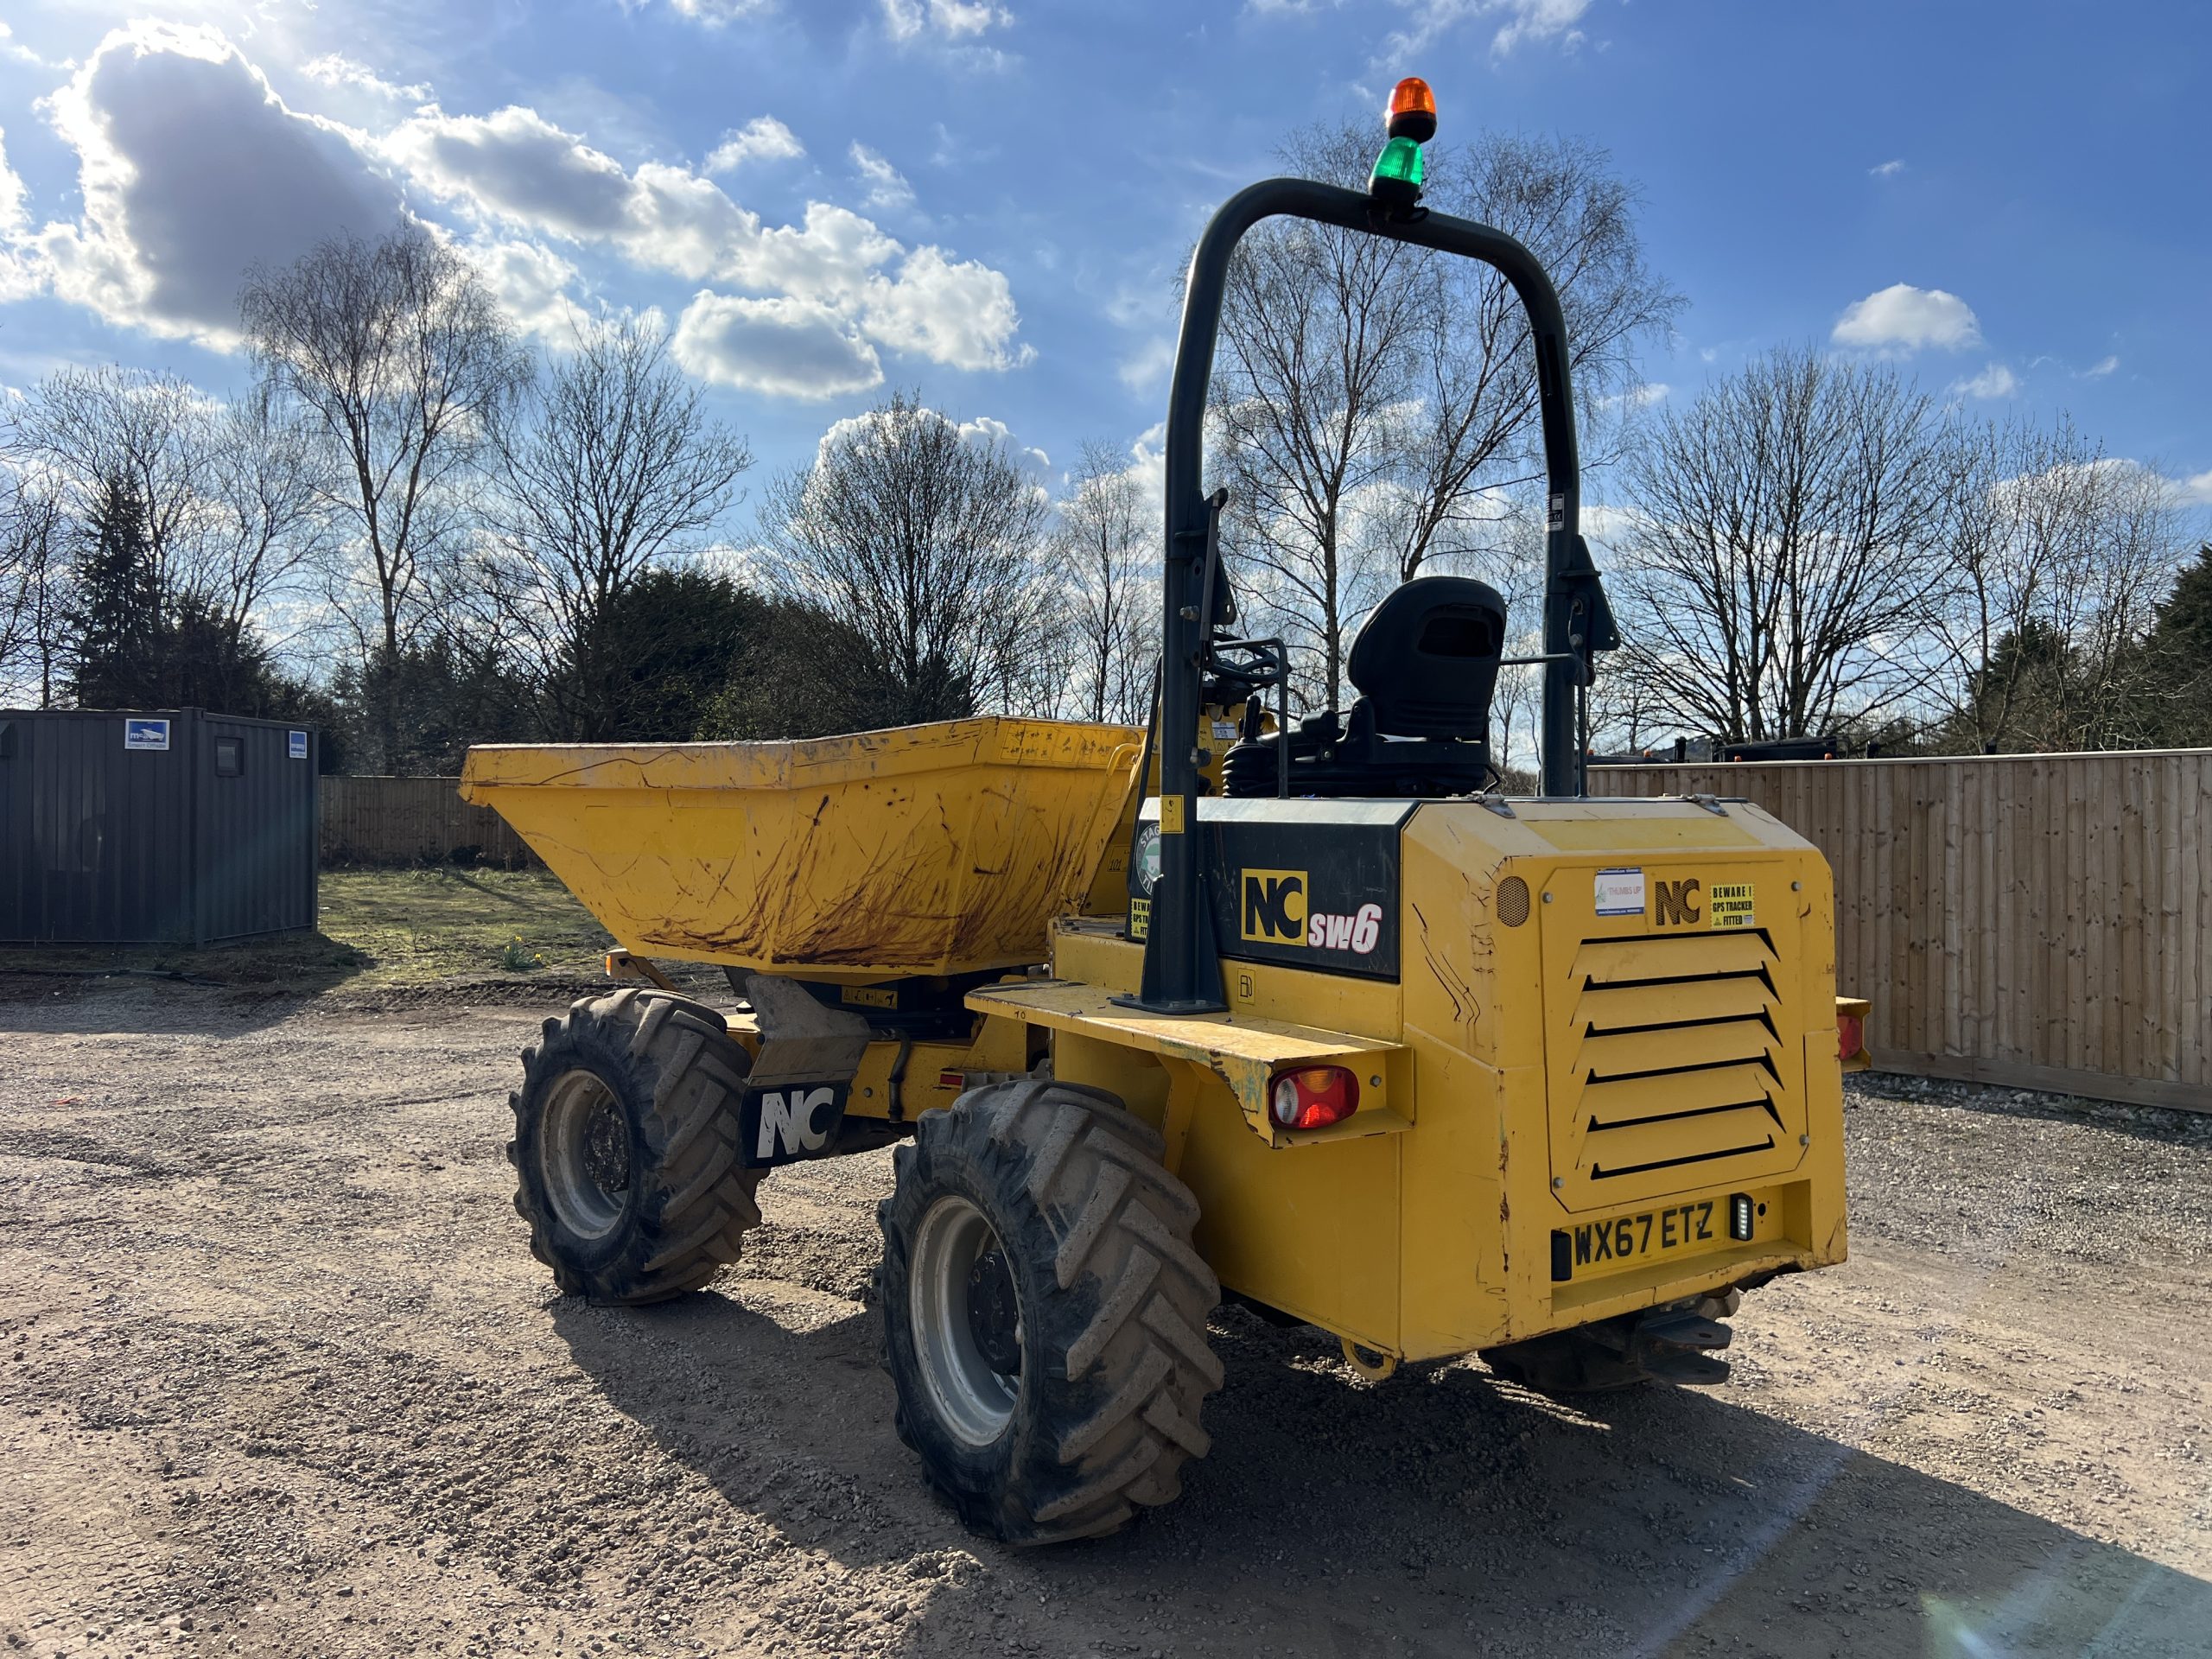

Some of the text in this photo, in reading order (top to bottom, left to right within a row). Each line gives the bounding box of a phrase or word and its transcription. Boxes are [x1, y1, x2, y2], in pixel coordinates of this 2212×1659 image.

[1140, 825, 1160, 848] STAG
[1245, 876, 1303, 939] NC
[1655, 878, 1700, 926] NC
[1713, 887, 1745, 898] BEWARE
[1713, 900, 1752, 912] GPS TRACKER
[1723, 915, 1743, 925] FITTED
[756, 1087, 834, 1158] NC
[1574, 1201, 1713, 1266] WX67 ETZ
